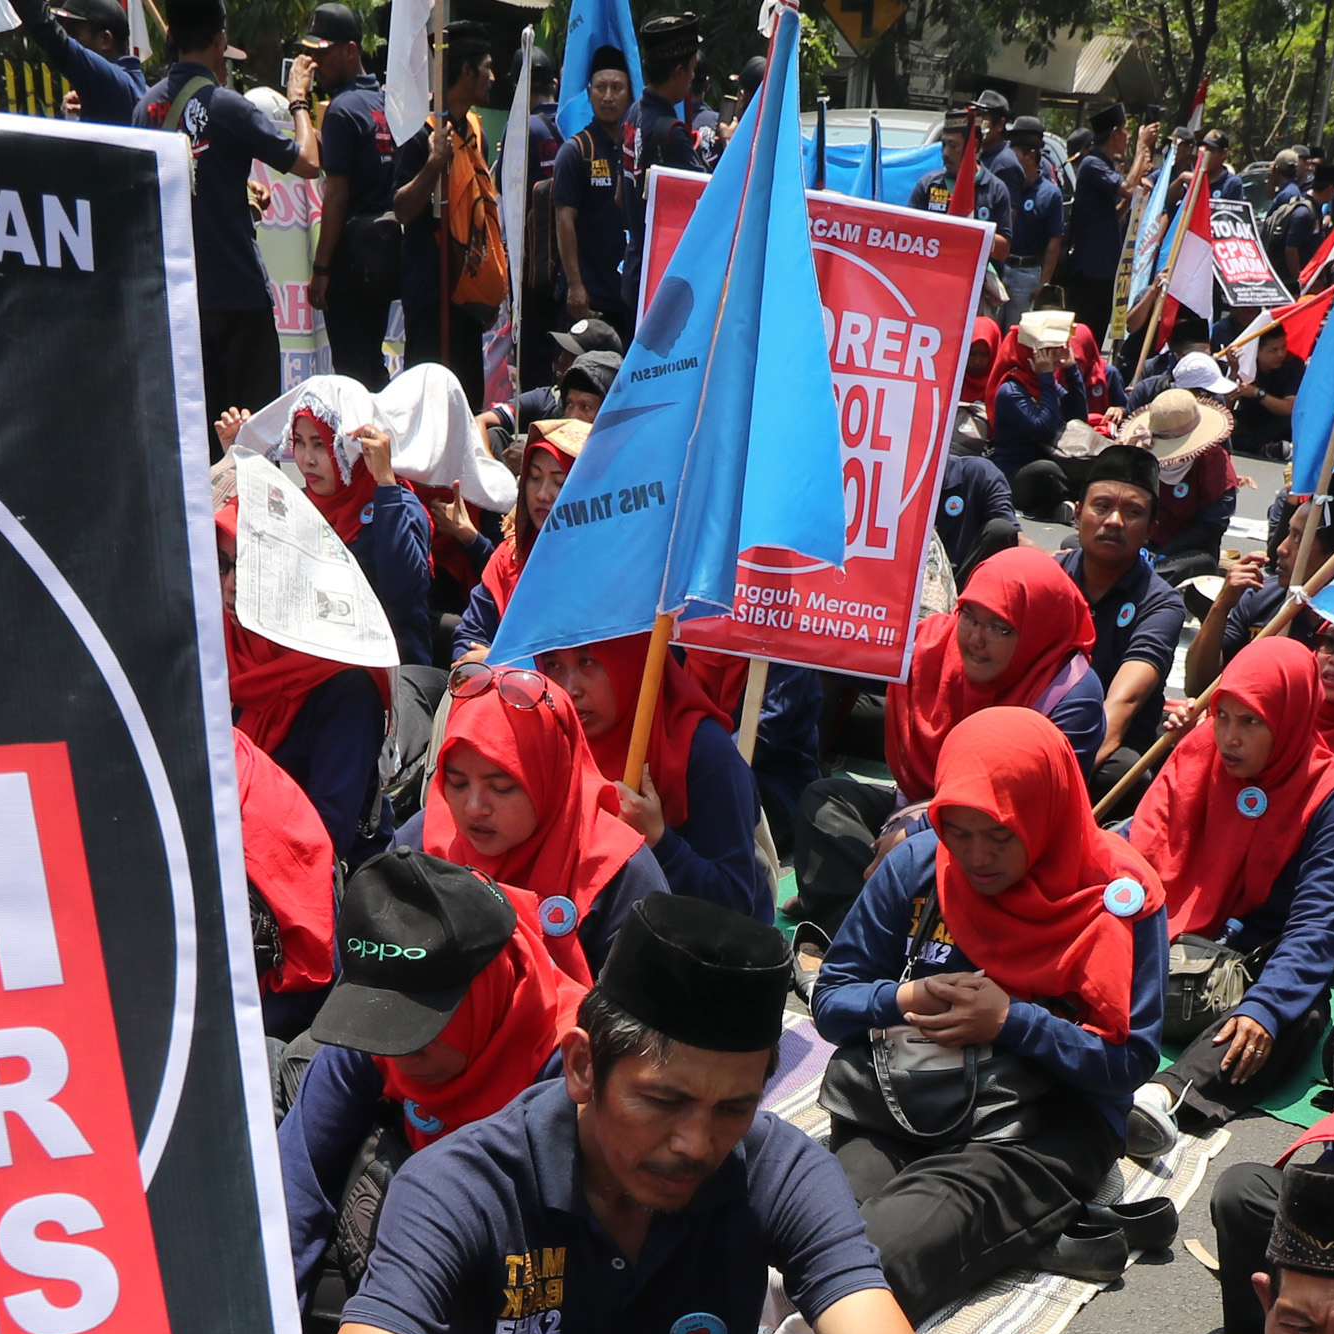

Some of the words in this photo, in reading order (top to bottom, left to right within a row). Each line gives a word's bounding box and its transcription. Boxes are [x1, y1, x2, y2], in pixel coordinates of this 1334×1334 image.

[590, 177, 612, 187] FHK2
[866, 227, 941, 259] BADAS
[1220, 256, 1268, 276] UMUM
[805, 591, 888, 622] Merana
[798, 614, 870, 643] BUNDA
[875, 626, 896, 647] !!!
[504, 1247, 566, 1287] TEAM
